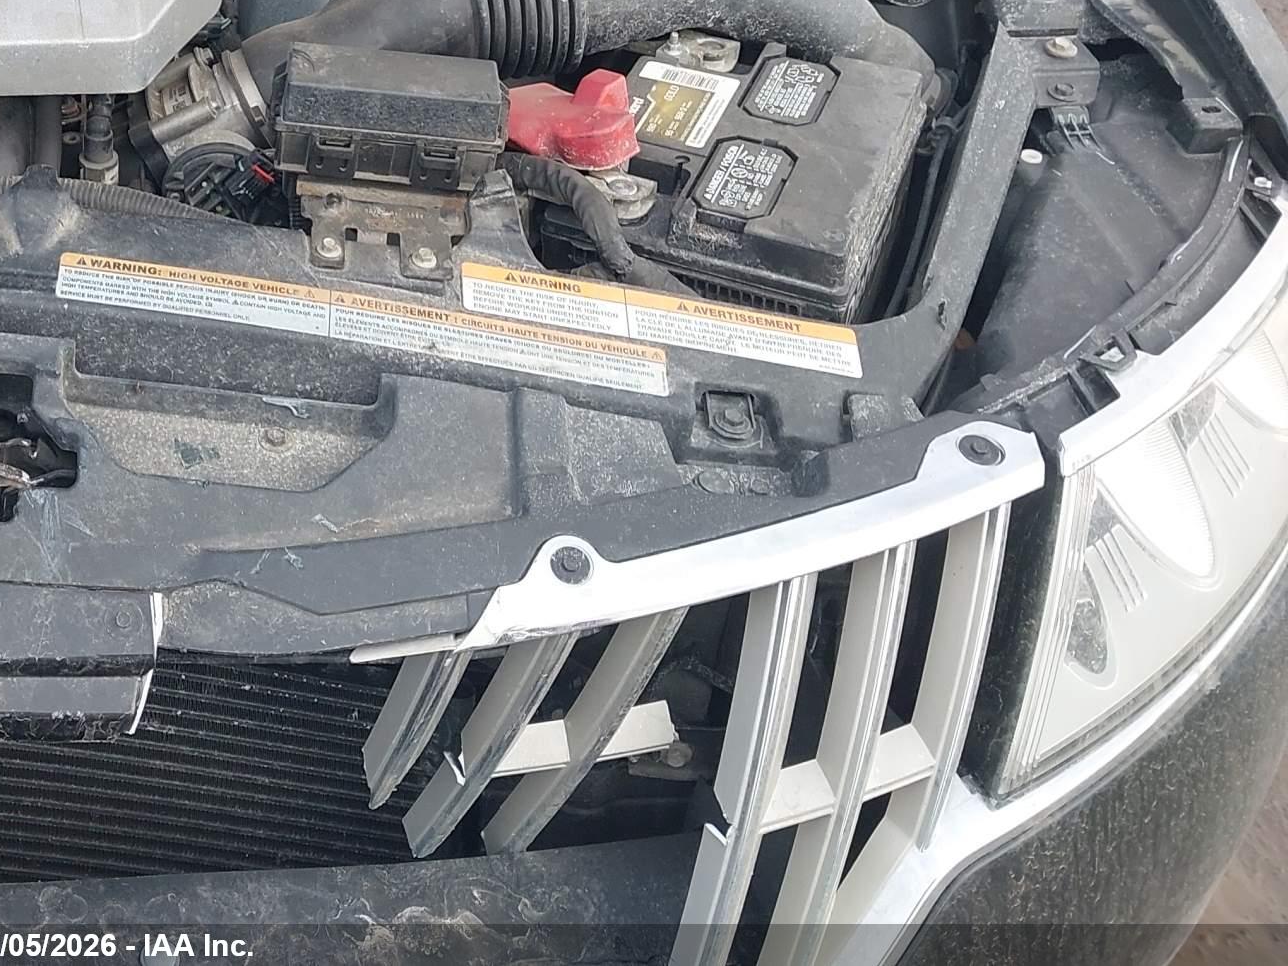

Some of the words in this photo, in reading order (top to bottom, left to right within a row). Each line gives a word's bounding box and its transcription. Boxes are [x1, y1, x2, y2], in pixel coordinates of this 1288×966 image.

[90, 259, 161, 276] WARNING:
[169, 270, 195, 281] HIGH
[200, 275, 248, 288] VOLTAGE
[253, 282, 297, 295] VEHICLE
[519, 275, 581, 293] WARNING
[351, 296, 448, 322] AVERTISSEMENT
[461, 316, 504, 332] CIRCUITS
[508, 324, 538, 338] HAUTE
[541, 331, 582, 346] TENSION
[585, 338, 597, 349] DU
[692, 305, 801, 332] AVERTISSEMENT
